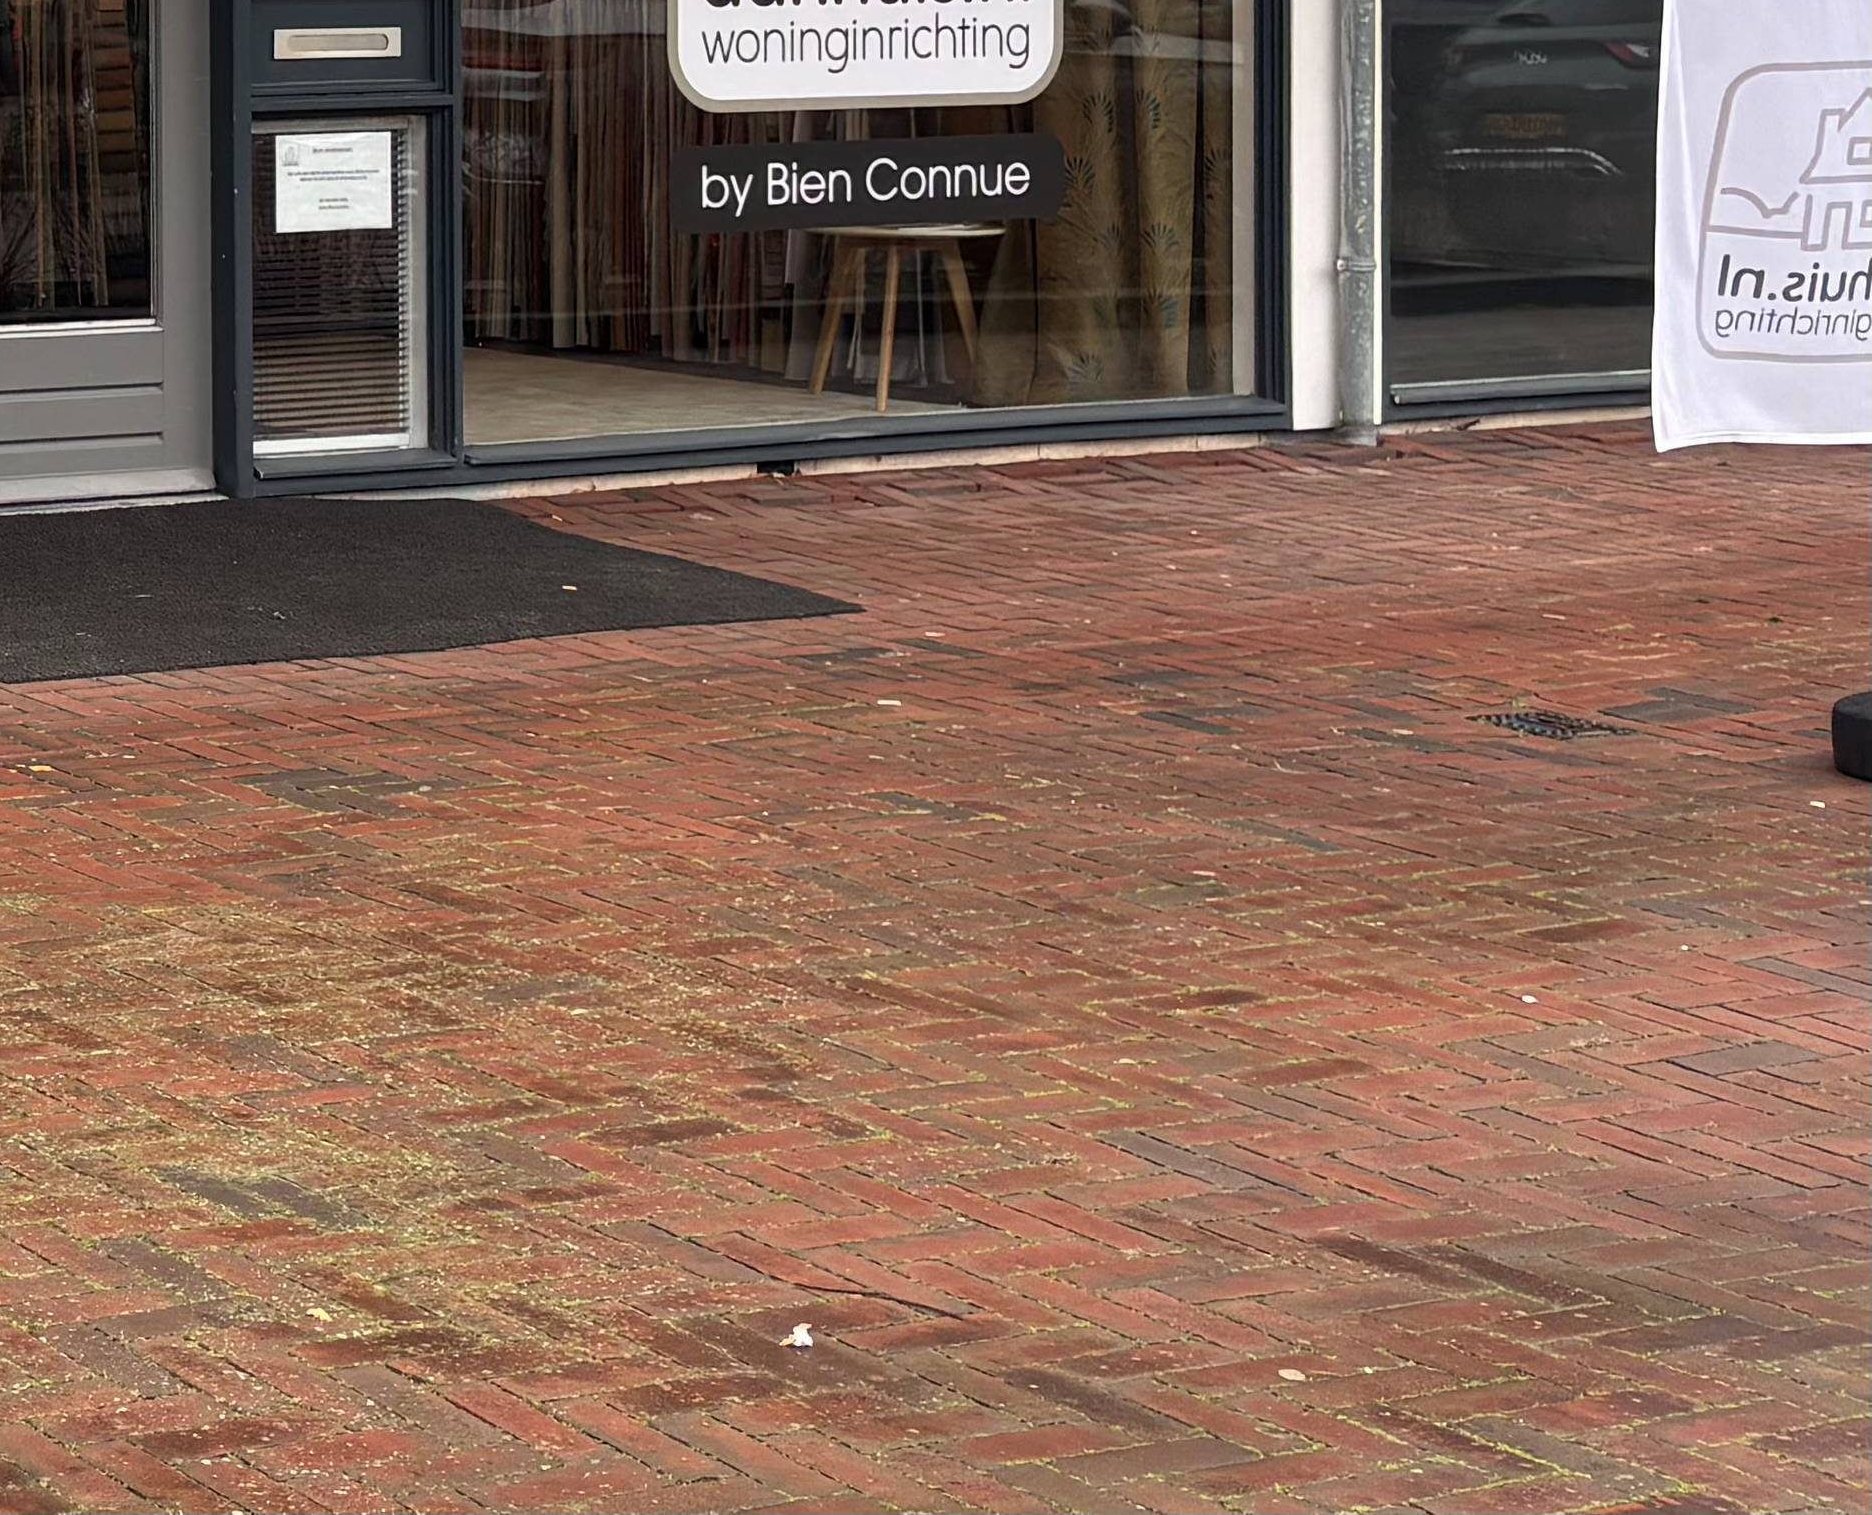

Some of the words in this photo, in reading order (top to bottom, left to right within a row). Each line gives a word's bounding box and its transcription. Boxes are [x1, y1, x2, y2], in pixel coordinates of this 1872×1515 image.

[701, 12, 1031, 73] woninginrichting
[701, 165, 754, 217] by
[767, 162, 852, 206] Bien
[865, 157, 1031, 201] Connue
